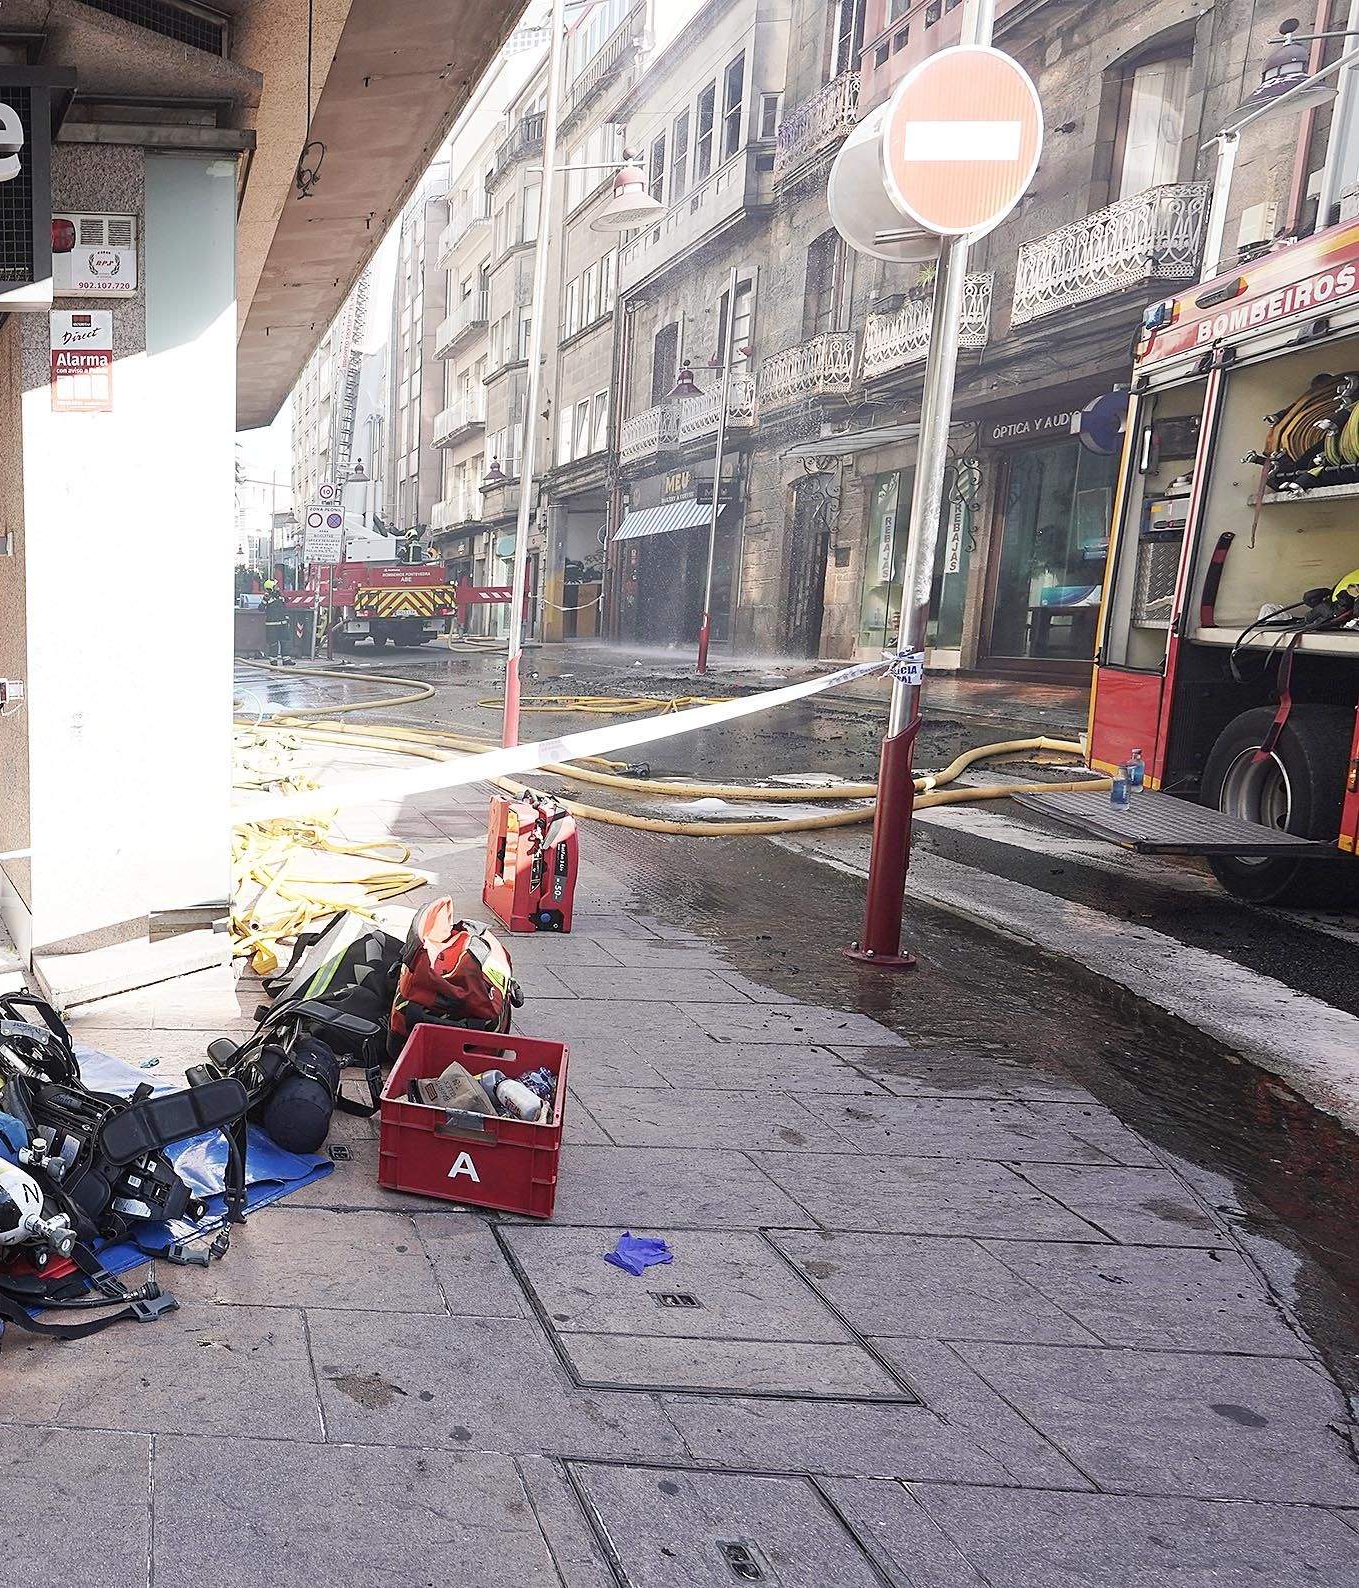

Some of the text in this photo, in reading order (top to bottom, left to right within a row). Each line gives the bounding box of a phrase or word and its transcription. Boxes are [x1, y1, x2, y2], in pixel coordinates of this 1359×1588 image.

[78, 281, 130, 290] 902.107.720
[1197, 265, 1356, 344] BOMBEIROS
[62, 327, 103, 345] Direct
[56, 353, 109, 368] Alarma
[993, 422, 1030, 439] ÓPTICA
[1034, 418, 1043, 430] Y
[665, 471, 691, 493] MEU
[882, 516, 892, 578] REBAJAS
[950, 503, 962, 571] REBAJAS
[447, 1151, 481, 1183] A
